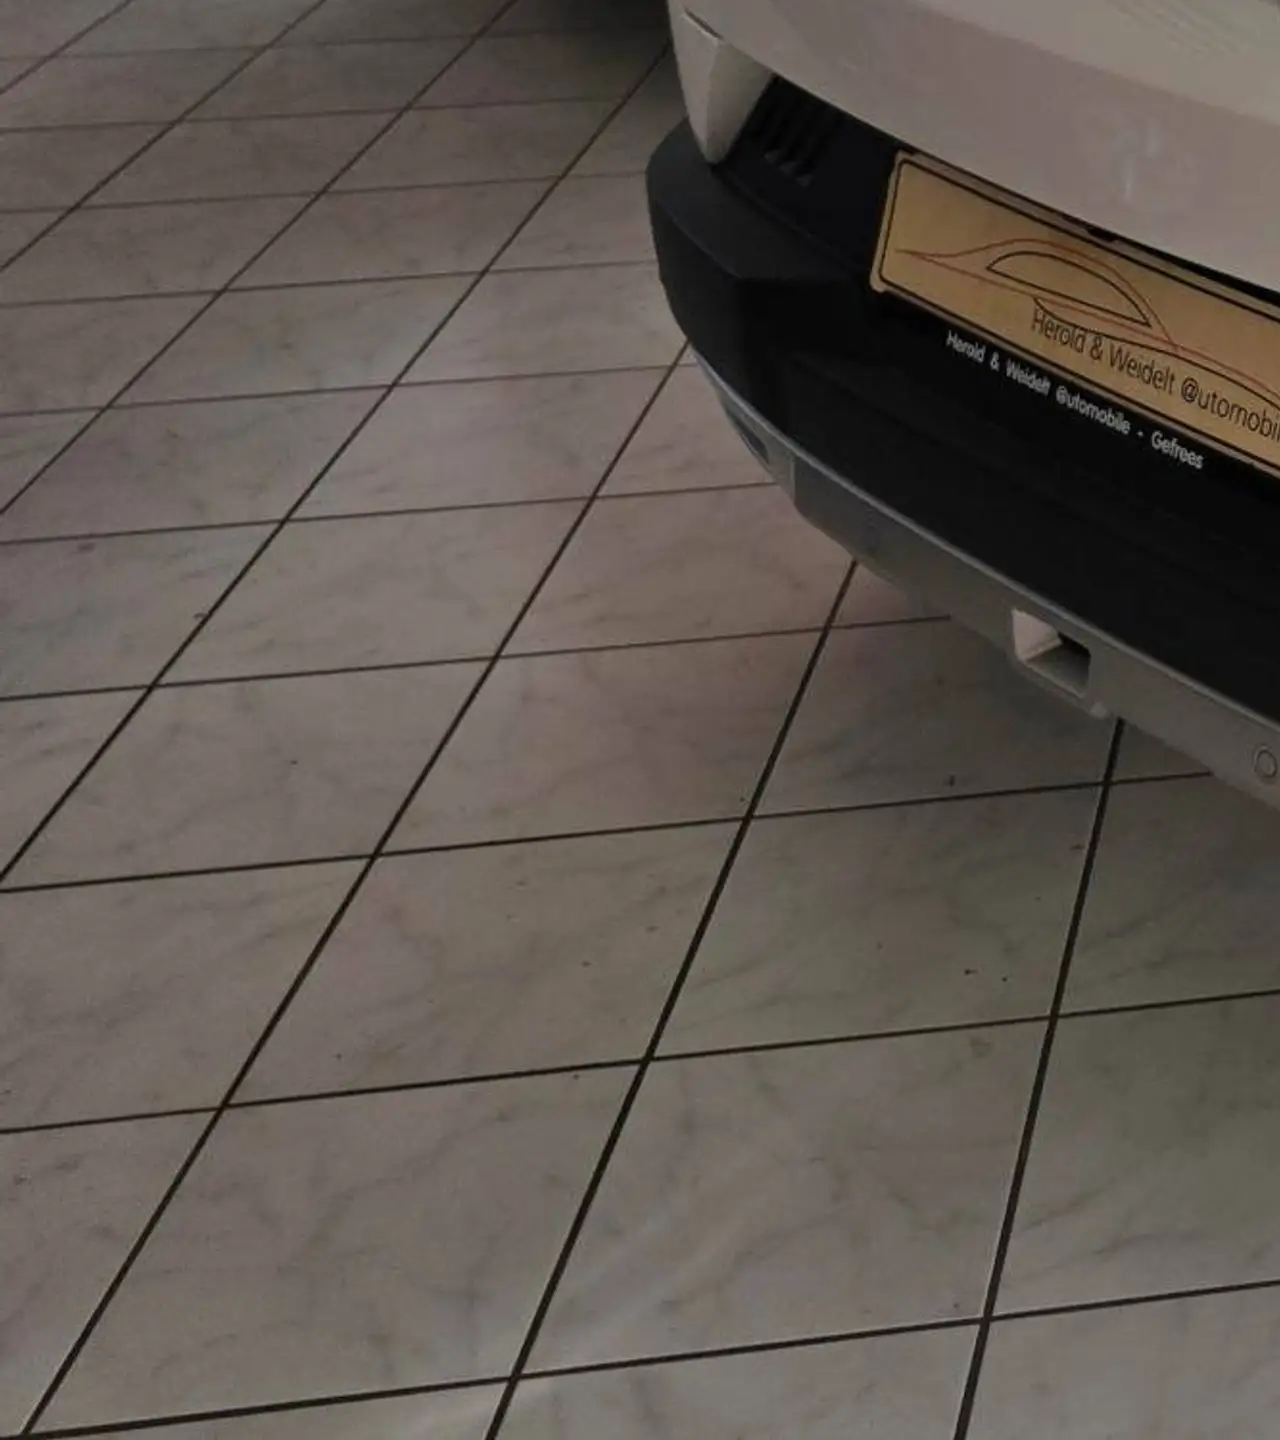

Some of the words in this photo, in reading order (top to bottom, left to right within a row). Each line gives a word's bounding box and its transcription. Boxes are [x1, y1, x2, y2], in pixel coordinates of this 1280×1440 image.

[946, 330, 987, 363] Herold
[989, 352, 1000, 372] &
[1006, 358, 1051, 397] Weidelt
[1056, 385, 1131, 436] @utomobile
[1151, 429, 1205, 470] Gefrees
[1031, 309, 1087, 354] Herold
[1089, 335, 1104, 361] &
[1108, 344, 1177, 396] Weidelt
